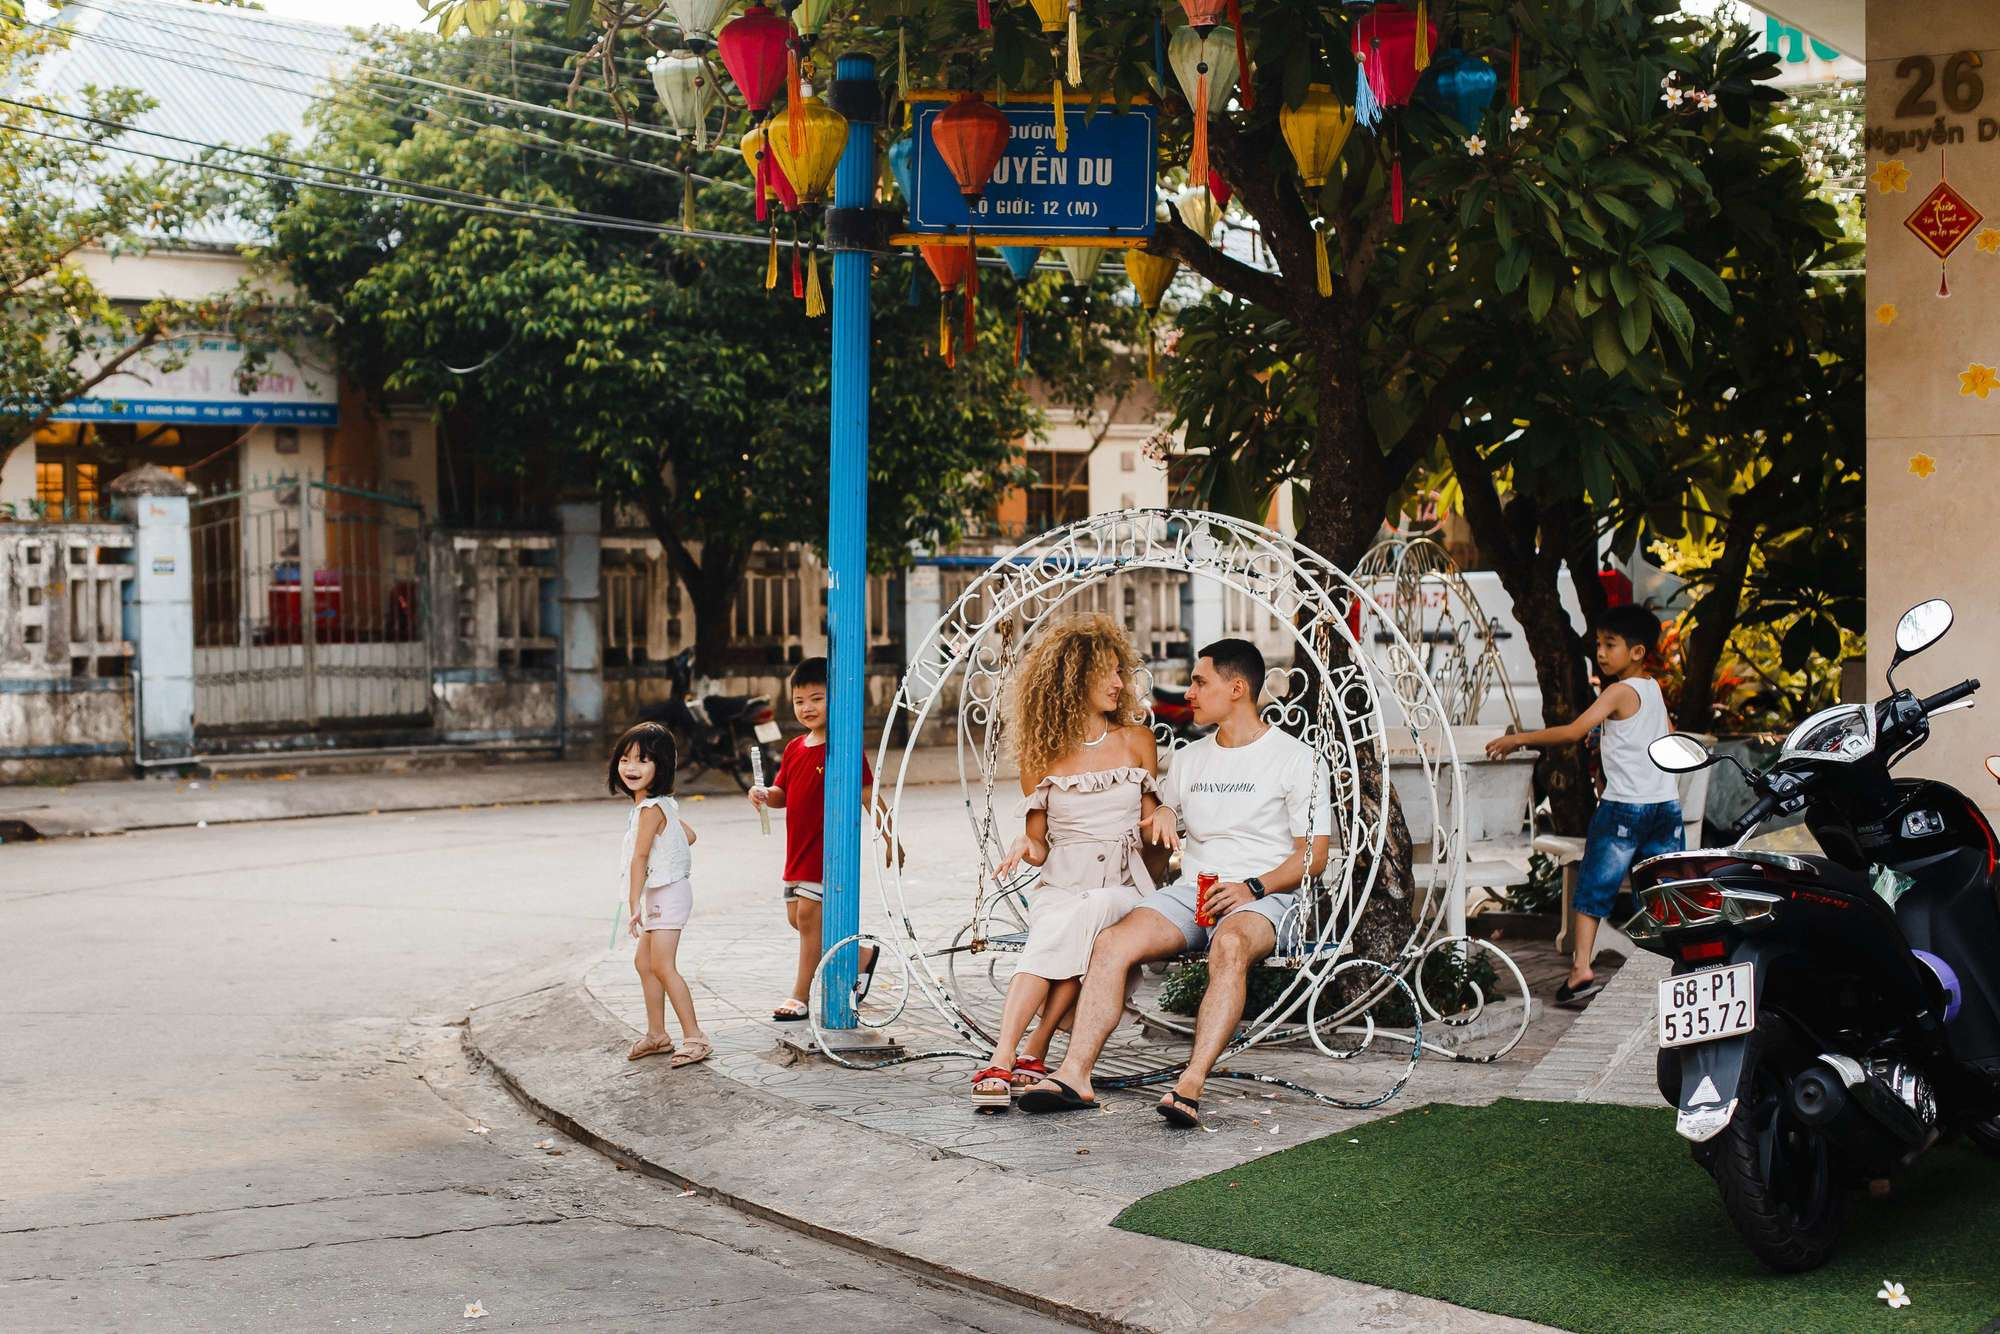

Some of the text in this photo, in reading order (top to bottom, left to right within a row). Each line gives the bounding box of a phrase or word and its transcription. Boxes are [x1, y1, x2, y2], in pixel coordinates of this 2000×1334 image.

[1895, 50, 1984, 119] 26
[1978, 117, 2000, 143] D
[987, 145, 1112, 186] UYỄN DU
[1042, 200, 1060, 215] 12
[1066, 201, 1098, 217] (M)
[1673, 970, 1735, 1009] 68-P1
[1665, 1000, 1747, 1042] 535.72
